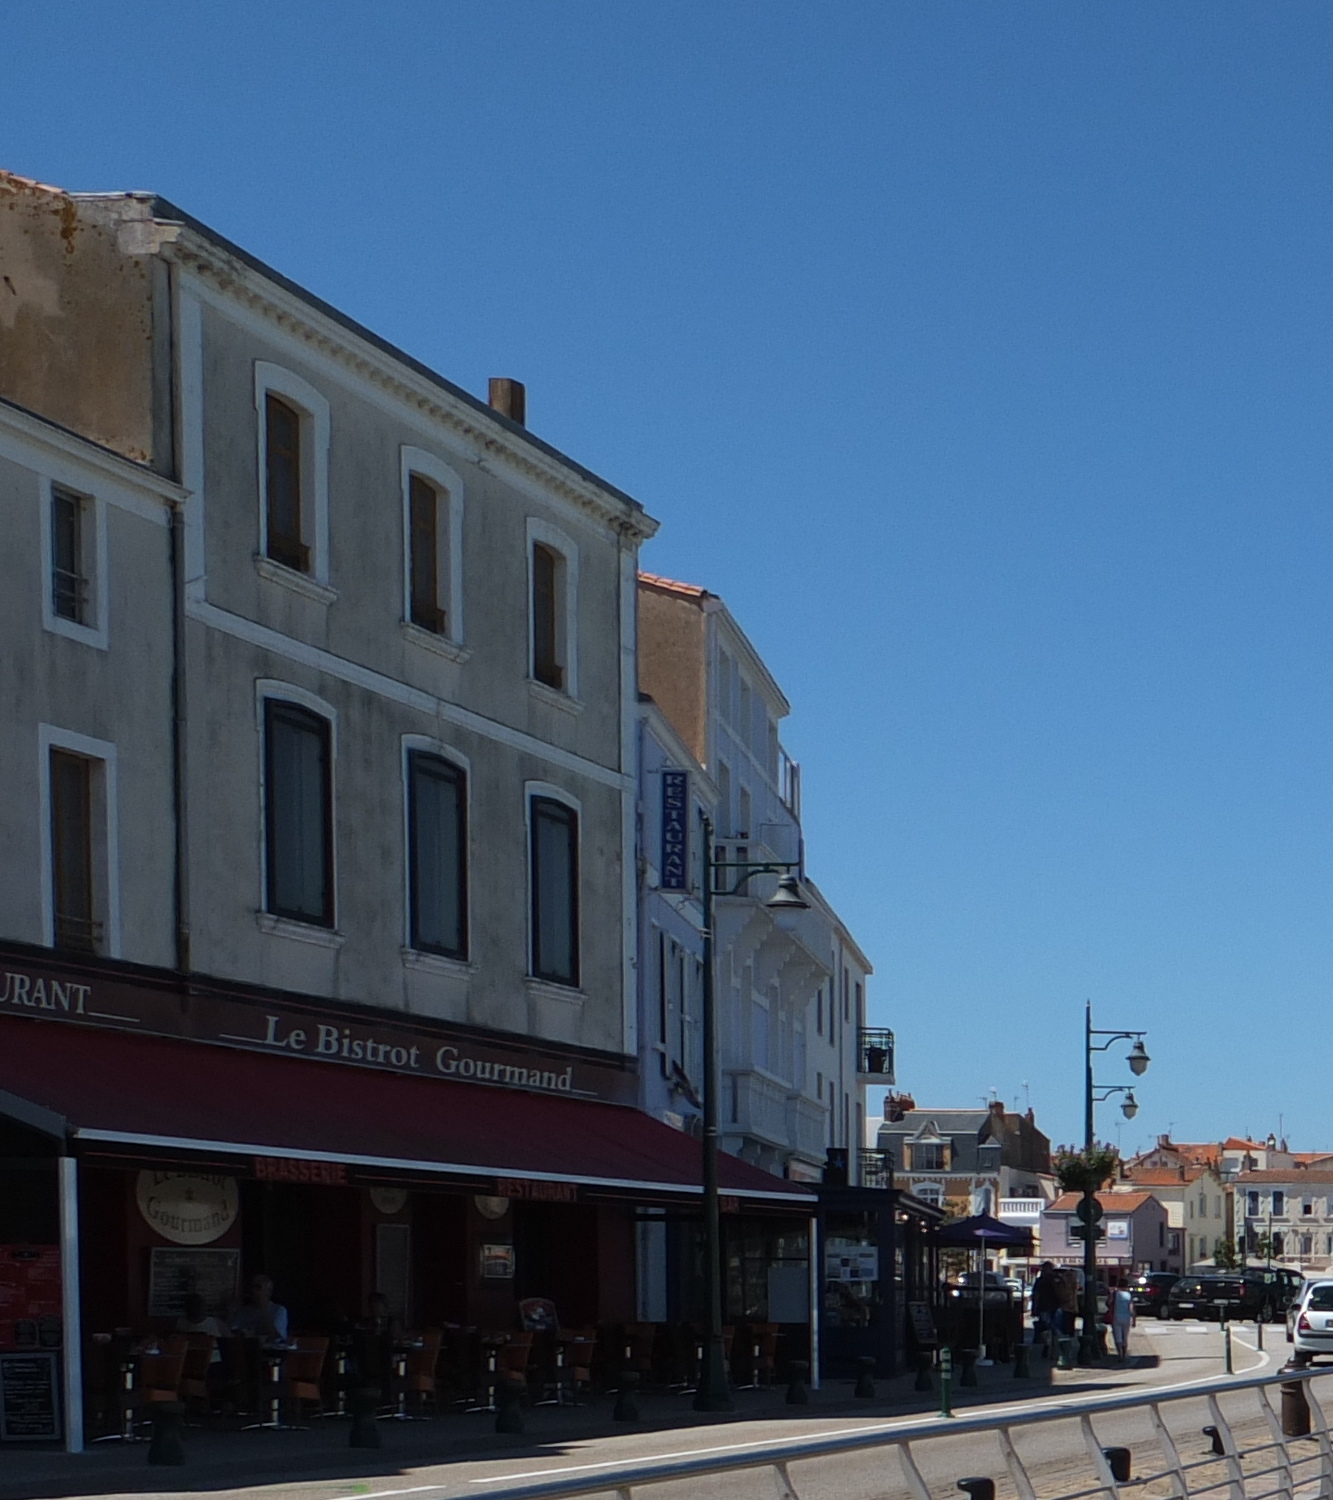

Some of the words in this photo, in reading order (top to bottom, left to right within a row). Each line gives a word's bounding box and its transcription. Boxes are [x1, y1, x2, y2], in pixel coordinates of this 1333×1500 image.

[664, 775, 684, 888] RESTAURANT
[265, 1015, 306, 1049] Le
[314, 1024, 420, 1068] Bistrot
[435, 1046, 573, 1091] Gourmand
[254, 1156, 347, 1185] BRASSERIE
[147, 1196, 229, 1233] Gourmand
